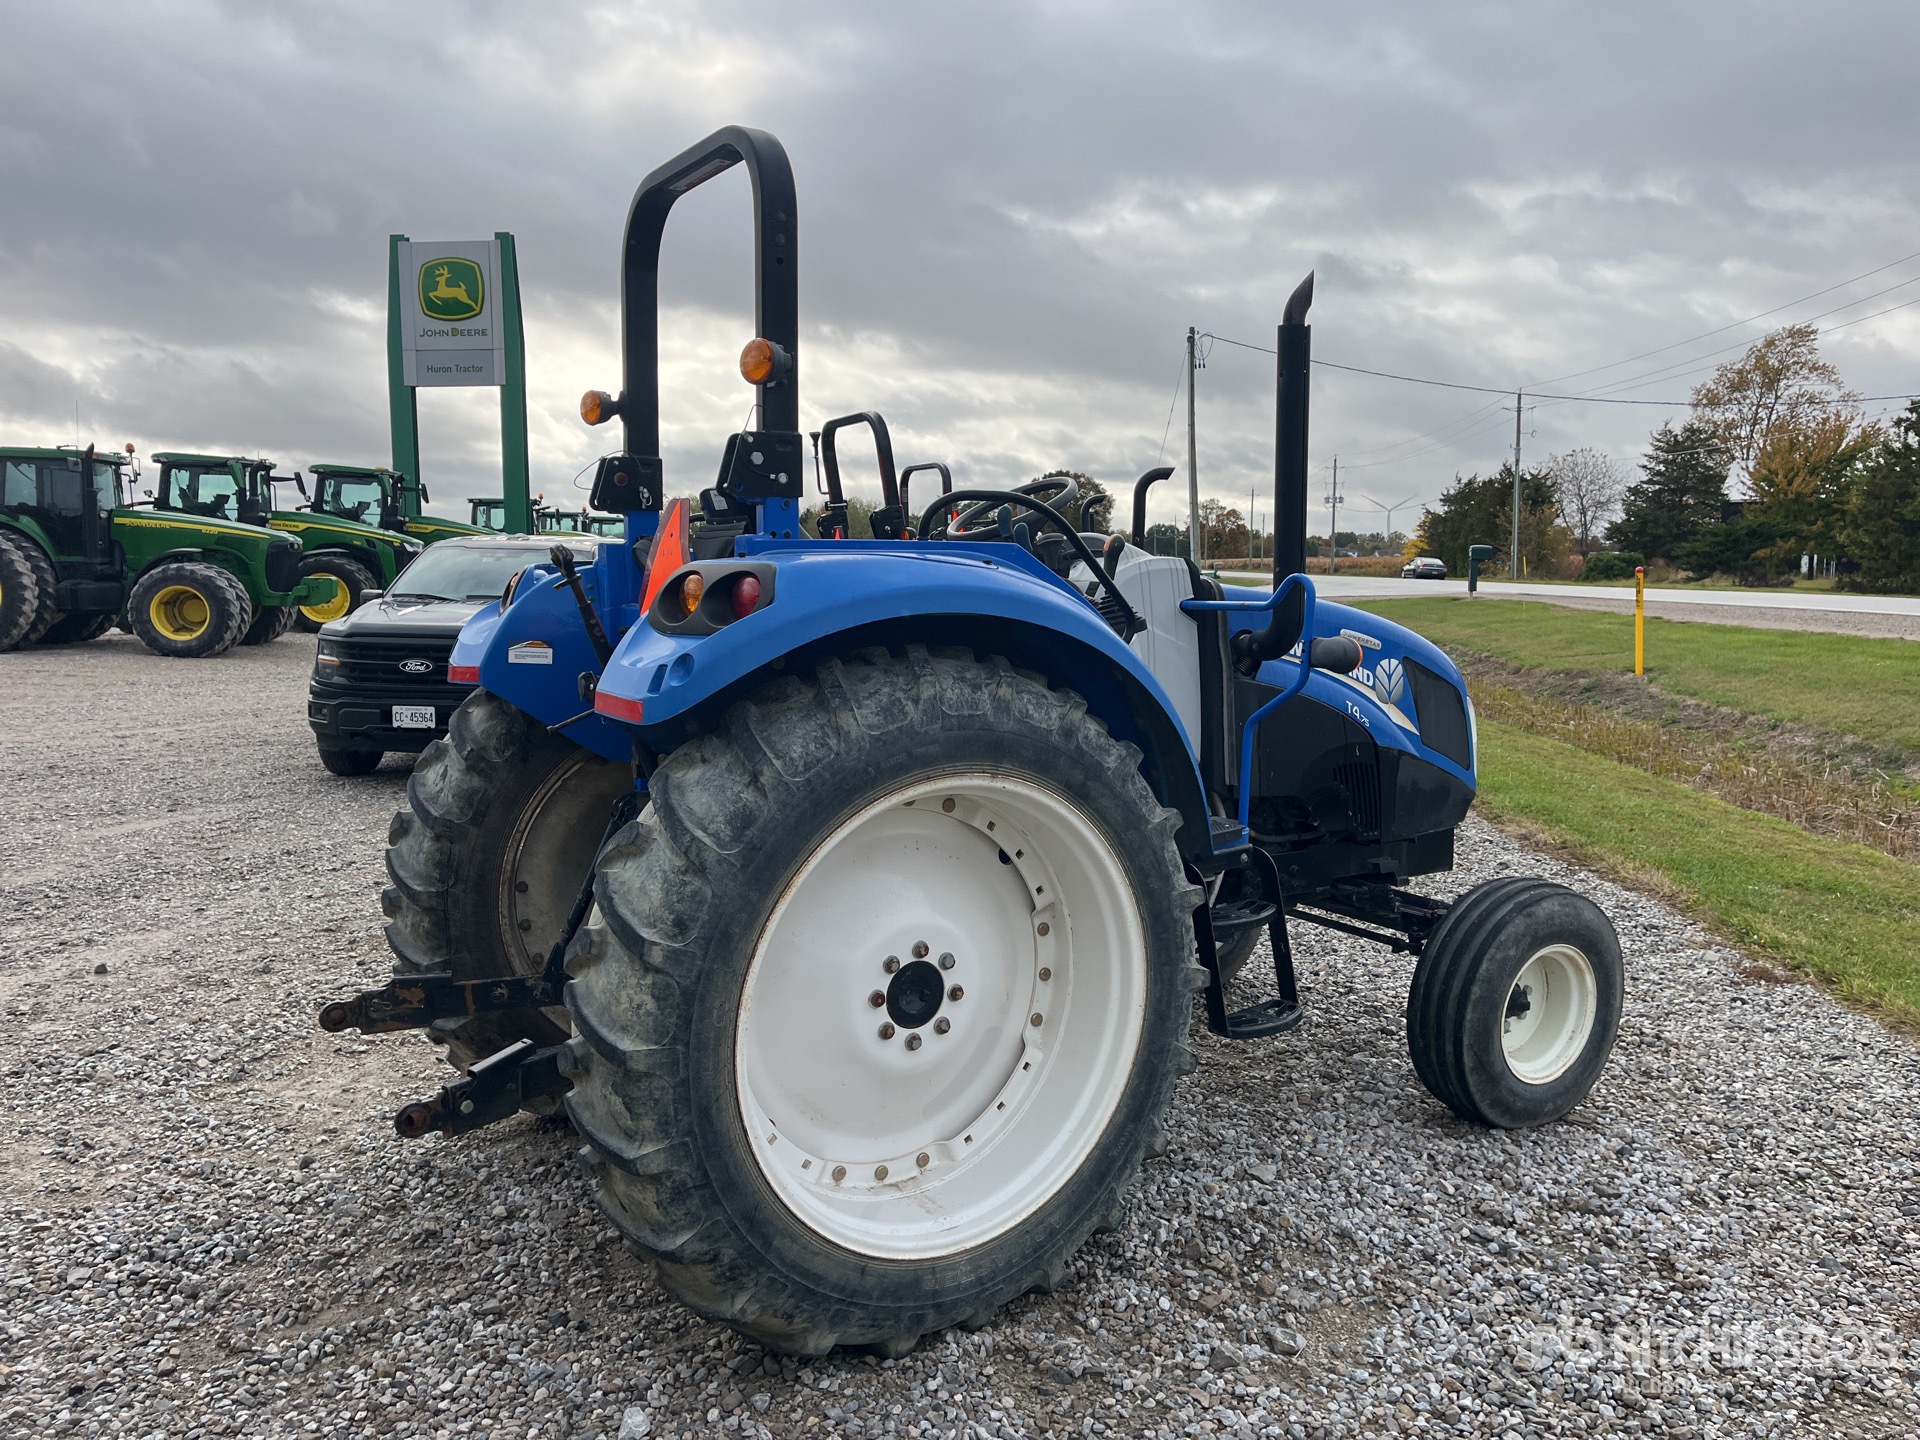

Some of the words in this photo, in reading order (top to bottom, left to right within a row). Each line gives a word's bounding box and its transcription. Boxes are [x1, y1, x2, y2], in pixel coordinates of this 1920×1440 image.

[419, 327, 449, 337] JOHN
[451, 327, 488, 337] DEERE
[426, 364, 452, 374] Huron
[454, 364, 484, 373] Tractor
[405, 662, 426, 671] Ford
[394, 711, 405, 722] CC
[409, 712, 433, 722] 45964
[1346, 700, 1370, 727] T4.75
